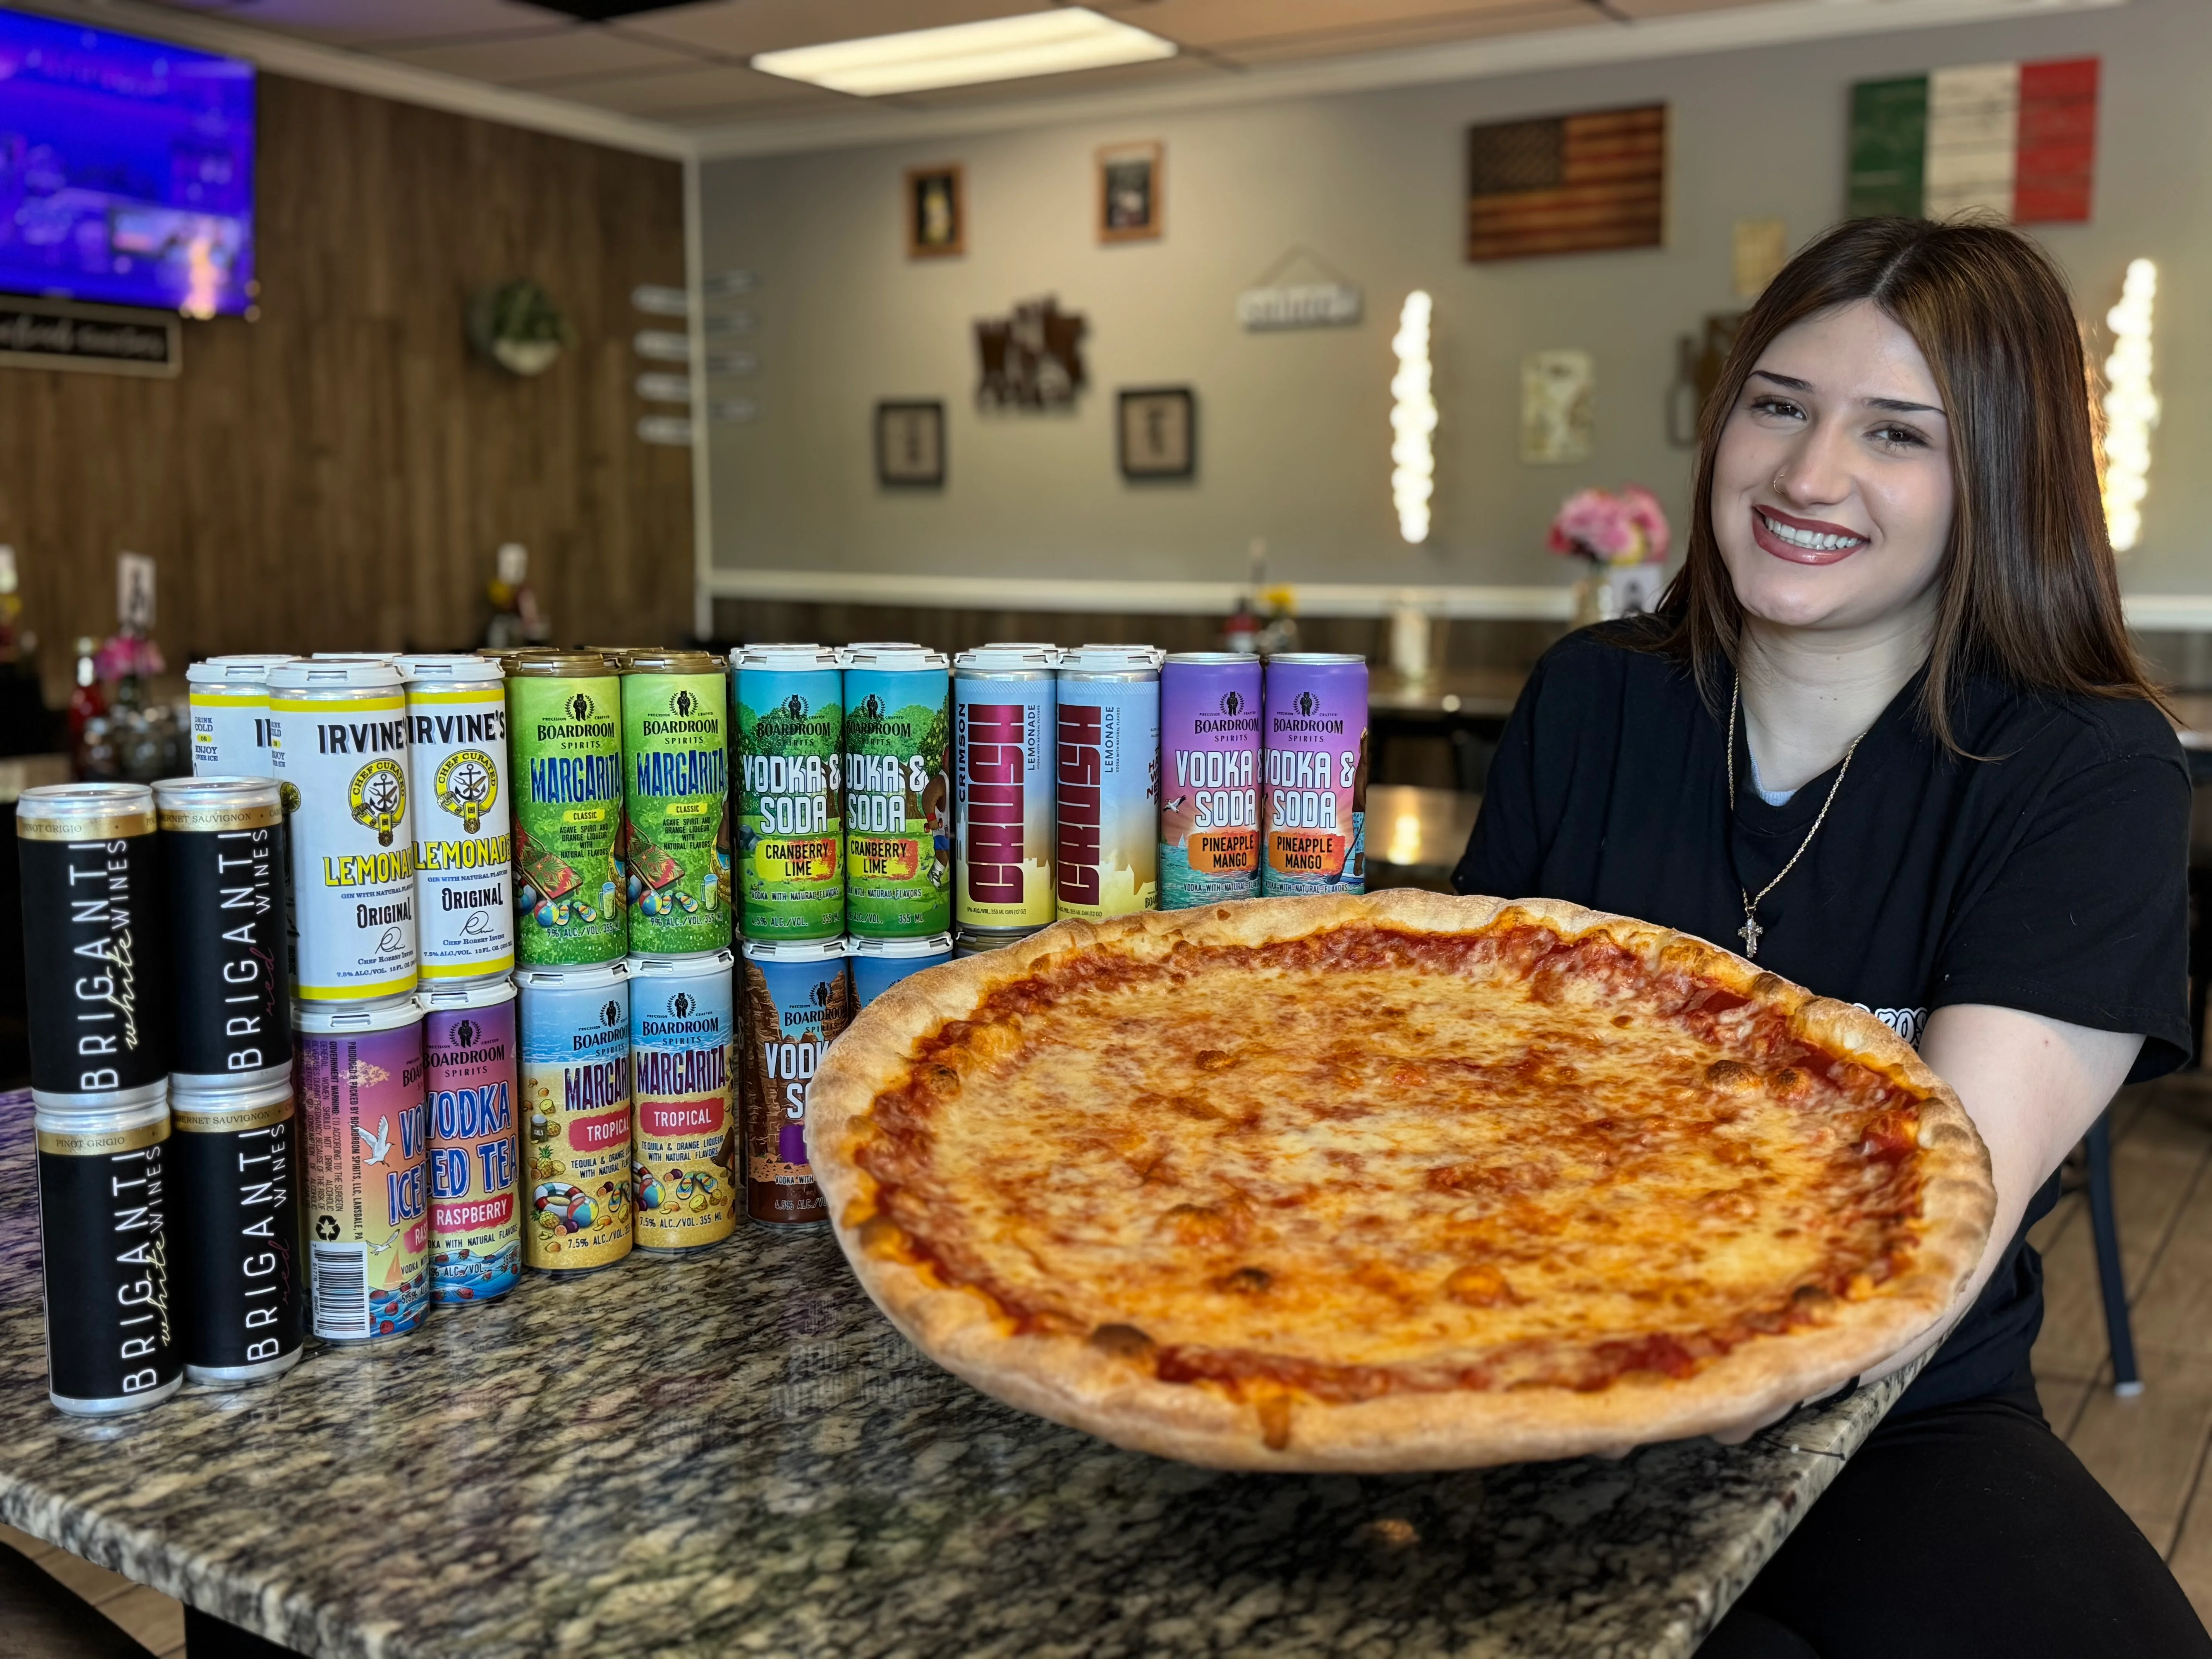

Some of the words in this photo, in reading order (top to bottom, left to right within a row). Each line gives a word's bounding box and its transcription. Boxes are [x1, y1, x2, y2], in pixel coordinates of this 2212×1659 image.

[195, 723, 213, 732] COLD
[406, 709, 505, 744] IRVINE'S
[538, 722, 615, 741] BOARDROOM
[644, 719, 718, 736] BOARDROOM
[757, 721, 831, 737] BOARDROOM
[1195, 718, 1259, 734] BOARDROOM
[1273, 718, 1343, 734] BOARDROOM
[317, 718, 406, 754] IRVINE'
[561, 740, 601, 749] SPIRITS
[665, 736, 703, 744] SPIRITS
[1027, 704, 1036, 771] LEMONADE
[1105, 706, 1114, 773] LEMONADE
[195, 745, 218, 754] ENJOY
[438, 756, 460, 784] CHEF
[462, 752, 496, 788] CURATED
[637, 747, 724, 796] MARGARITA
[742, 754, 823, 793] VODKA
[829, 753, 841, 791] &
[845, 753, 899, 793] ODKA
[909, 755, 927, 792] &
[1175, 749, 1253, 788] VODKA
[1264, 747, 1331, 789] VODKA
[1340, 751, 1355, 788] &
[353, 764, 379, 796] CHEF
[376, 762, 406, 797] CURATED
[530, 752, 620, 804] MARGARITA
[573, 811, 597, 820] CLASSIC
[676, 805, 699, 814] CLASSIC
[759, 795, 828, 834] SODA
[847, 795, 906, 833] SODA
[1195, 788, 1256, 828] SODA
[1273, 790, 1337, 828] SODA
[192, 812, 251, 823] SAUVIGNON
[683, 817, 699, 826] SPIRIT
[45, 824, 82, 833] GRIGIO
[562, 833, 584, 842] ORANGE
[587, 832, 607, 840] LIQUEUR
[580, 824, 596, 833] SPIRIT
[599, 823, 608, 831] AND
[665, 826, 685, 834] ORANGE
[689, 824, 710, 833] LIQUEUR
[412, 833, 511, 870] LEMONADE
[663, 842, 686, 850] NATURAL
[689, 841, 711, 849] FLAVORS
[766, 842, 828, 860] CRANBERRY
[850, 840, 907, 858] CRANBERRY
[1202, 834, 1254, 852] PINEAPPLE
[1277, 836, 1333, 853] PINEAPPLE
[561, 850, 585, 859] NATURAL
[588, 848, 608, 857] FLAVORS
[1213, 852, 1247, 868] MANGO
[1285, 854, 1322, 869] MANGO
[252, 829, 271, 914] WINES
[322, 847, 413, 886] LEMONAD
[785, 861, 812, 877] LIME
[864, 859, 887, 874] LIME
[107, 840, 129, 929] WINES
[460, 873, 489, 881] NATURAL
[376, 888, 401, 896] NATURAL
[772, 892, 787, 901] WITH
[790, 891, 816, 901] NATURAL
[867, 889, 891, 899] NATURAL
[895, 888, 922, 899] FLAVORS
[1183, 883, 1202, 892] VODKA
[1206, 883, 1221, 891] WITH
[1224, 882, 1245, 891] NATURAL
[1279, 883, 1291, 891] WITH
[1295, 884, 1319, 894] NATURAL
[1324, 884, 1348, 893] FLAVORS
[442, 883, 503, 911] ORIGINAL
[357, 897, 412, 928] ORIGINAL
[899, 914, 911, 924] 355
[915, 913, 924, 922] ML
[651, 917, 663, 927] 9%
[464, 937, 488, 945] ROBERT
[547, 928, 560, 938] 9%
[218, 832, 262, 1070] BRIGANTI
[379, 954, 401, 963] ROBERT
[69, 843, 119, 1090] BRIGANTI
[642, 1017, 719, 1036] BOARDROOM
[573, 1022, 629, 1051] BOARDROO
[662, 1036, 701, 1045] SPIRITS
[348, 1041, 358, 1073] PRODUCED
[422, 1044, 505, 1068] BOARDROOM
[596, 1042, 625, 1057] SPIRITS
[329, 1041, 338, 1083] GOVERNMENT
[637, 1044, 726, 1096] MARGARITA
[445, 1066, 488, 1077] SPIRITS
[564, 1055, 630, 1112] MARGARI
[331, 1085, 340, 1116] WARNING:
[349, 1082, 359, 1105] PACKED
[213, 1110, 270, 1124] SAUVIGNON
[654, 1108, 712, 1128] TROPICAL
[350, 1116, 360, 1154] BOARDROOM
[587, 1115, 630, 1142] TROPICAL
[56, 1139, 83, 1147] PINOT
[87, 1137, 125, 1147] GRIGIO
[321, 1077, 330, 1100] WOMEN
[326, 1179, 334, 1211] ALCOHOLIC
[333, 1127, 342, 1160] ACCORDING
[641, 1141, 664, 1151] TEQUILA
[667, 1142, 673, 1151] &
[677, 1140, 700, 1151] ORANGE
[703, 1135, 724, 1149] LIQUEUR
[476, 1134, 519, 1193] TEA
[571, 1158, 597, 1169] TEQUILA
[600, 1156, 606, 1165] &
[608, 1150, 625, 1162] ORANGE
[648, 1152, 662, 1161] WITH
[665, 1151, 691, 1161] NATURAL
[695, 1149, 719, 1160] FLAVORS
[271, 1123, 287, 1208] WINES
[352, 1156, 361, 1181] SPIRITS,
[580, 1167, 595, 1179] WITH
[599, 1164, 620, 1176] NATURAL
[775, 1176, 795, 1185] VODKA
[799, 1175, 814, 1184] WITH
[146, 1146, 164, 1233] WINES
[335, 1184, 343, 1212] SURGEON
[436, 1199, 507, 1226] RASPBERRY
[775, 1199, 794, 1210] 4.5%
[353, 1197, 362, 1231] LANSDALE,
[640, 1216, 656, 1228] 7.5%
[700, 1215, 711, 1225] 355
[714, 1211, 723, 1221] ML
[239, 1129, 280, 1361] BRIGANTI
[445, 1239, 463, 1249] WITH
[467, 1233, 495, 1246] NATURAL
[499, 1223, 518, 1240] FLAVORS
[568, 1238, 589, 1249] 7.5%
[112, 1151, 157, 1393] BRIGANTI
[401, 1262, 419, 1276] VODKA
